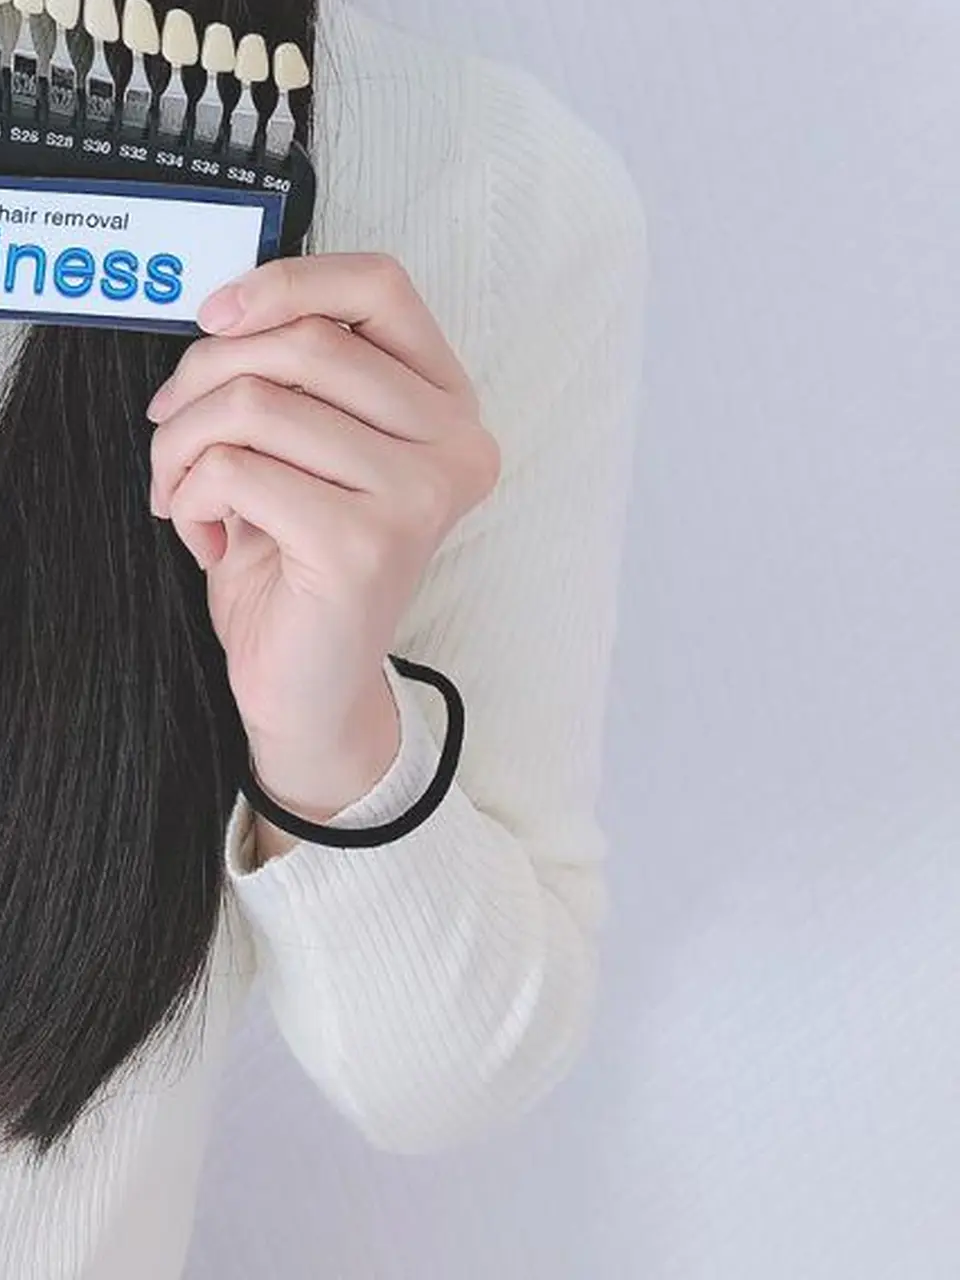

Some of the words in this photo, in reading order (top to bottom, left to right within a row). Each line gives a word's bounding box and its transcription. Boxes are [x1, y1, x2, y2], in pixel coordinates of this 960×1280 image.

[82, 138, 112, 154] S30
[119, 144, 148, 161] S32
[155, 151, 184, 168] S34
[262, 174, 291, 192] S40
[43, 210, 130, 231] removal
